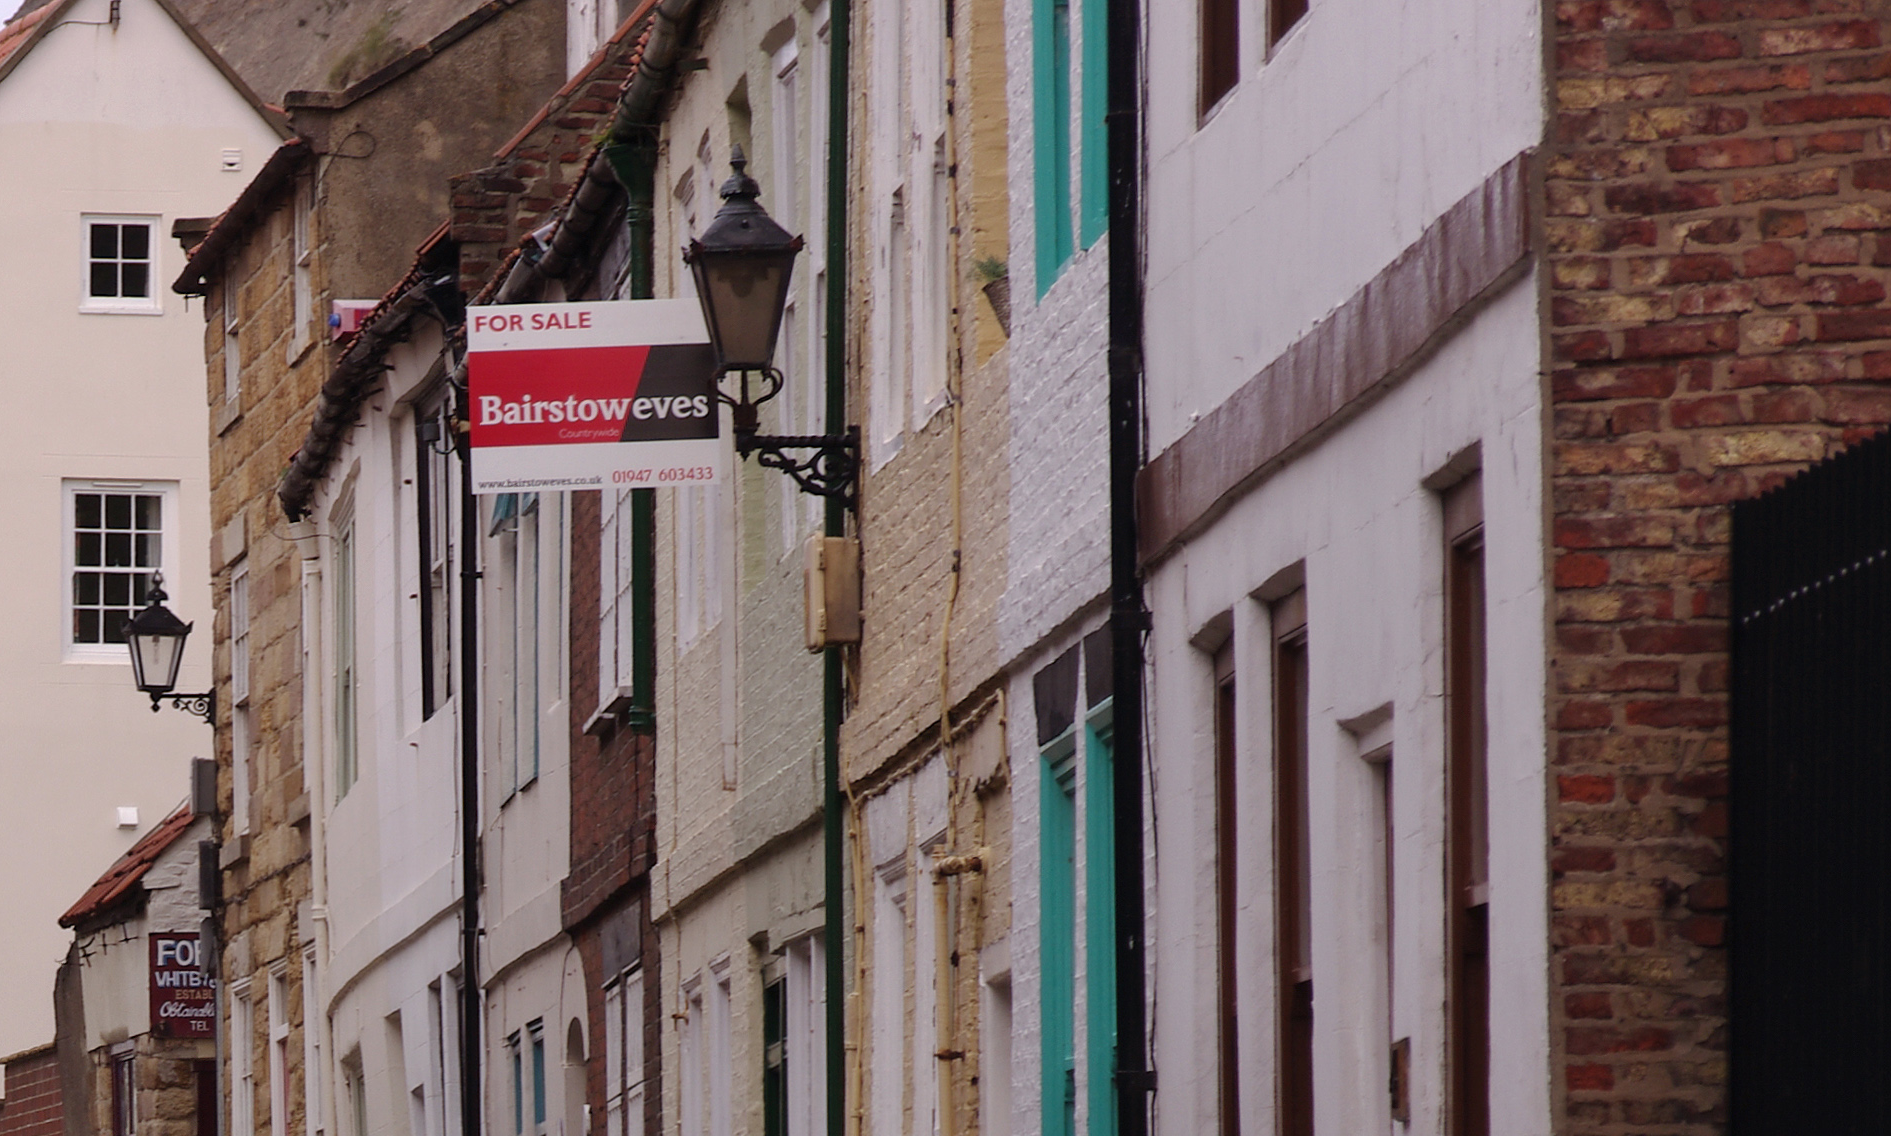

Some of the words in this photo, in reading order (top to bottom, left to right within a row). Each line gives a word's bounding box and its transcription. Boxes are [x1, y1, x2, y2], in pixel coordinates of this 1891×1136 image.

[474, 313, 524, 333] FOR
[531, 311, 593, 331] SALE
[478, 393, 709, 426] Bairstoweves
[558, 426, 620, 440] Countrywide
[478, 475, 603, 489] www.bairstoweves.co.uk
[612, 469, 653, 484] 01947
[659, 467, 714, 482] 603433
[189, 1020, 210, 1031] TEL
